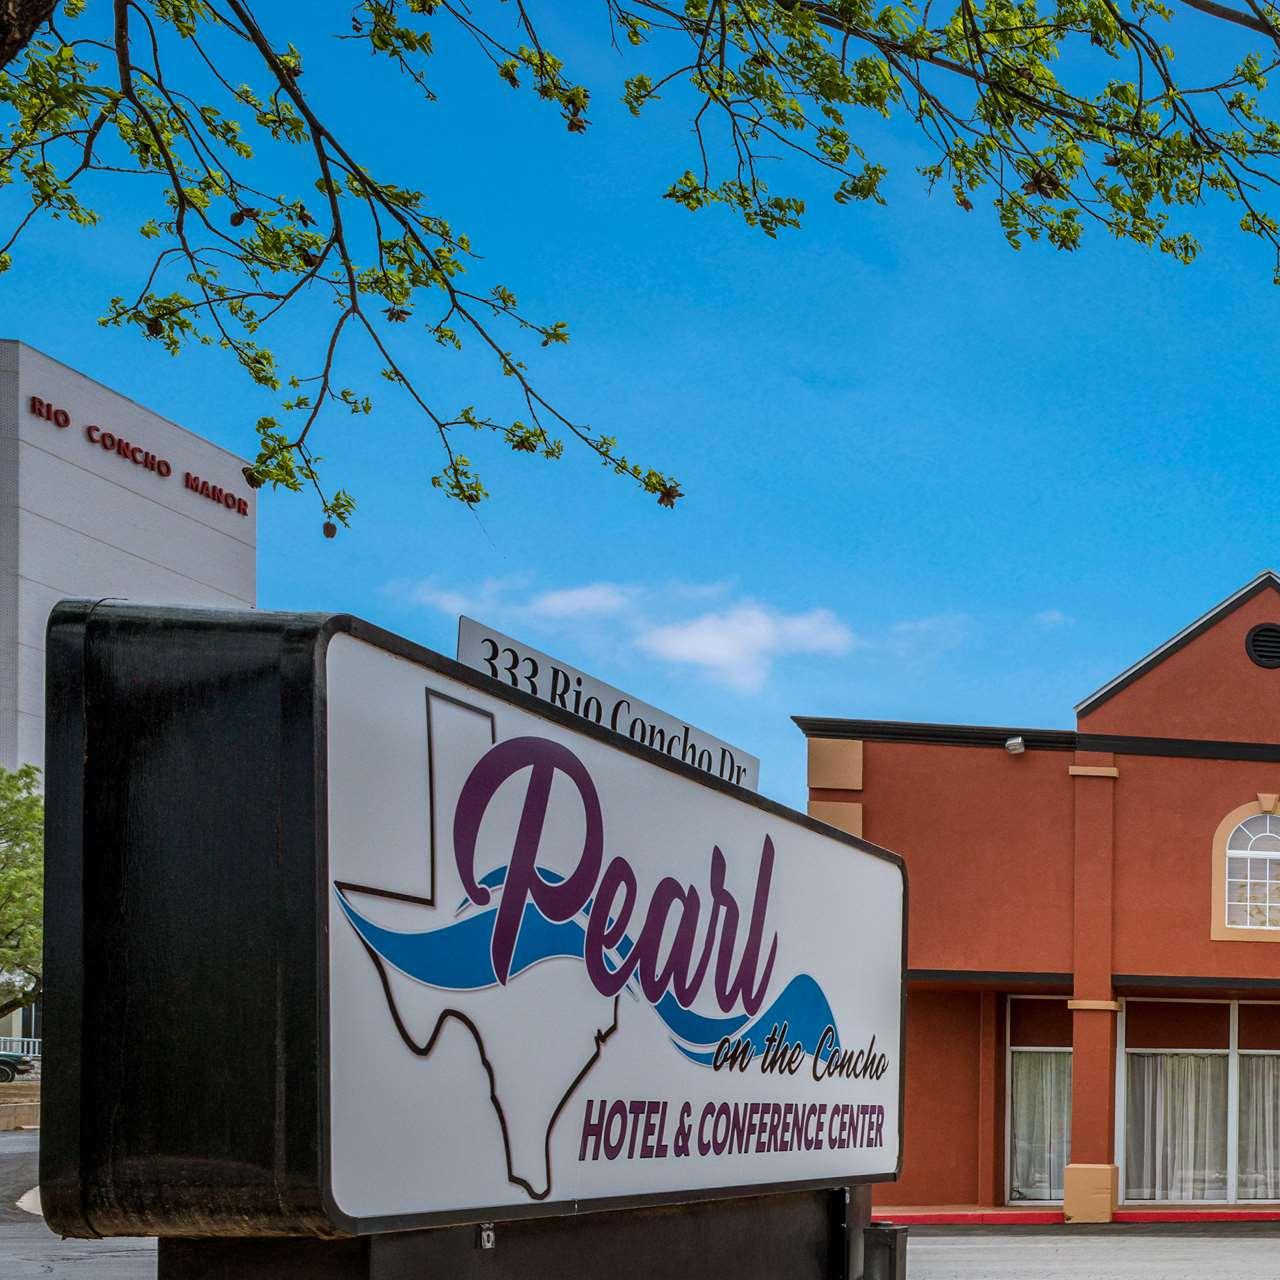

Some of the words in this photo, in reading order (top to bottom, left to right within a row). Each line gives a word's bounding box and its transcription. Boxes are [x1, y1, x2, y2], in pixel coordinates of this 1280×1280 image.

[31, 396, 71, 428] RIO
[86, 425, 172, 477] CONCHO
[185, 472, 249, 516] MANOR
[481, 638, 539, 696] 333
[551, 666, 603, 723] Rio
[611, 700, 713, 772] Concho
[719, 747, 747, 785] Dr
[453, 736, 777, 1017] Pearl
[713, 1037, 756, 1073] on
[760, 1022, 805, 1076] the
[812, 1025, 889, 1082] Concho
[578, 1099, 669, 1162] HOTEL
[674, 1101, 693, 1158] &
[697, 1101, 828, 1157] CONFERENCE
[828, 1103, 886, 1150] CENTER
